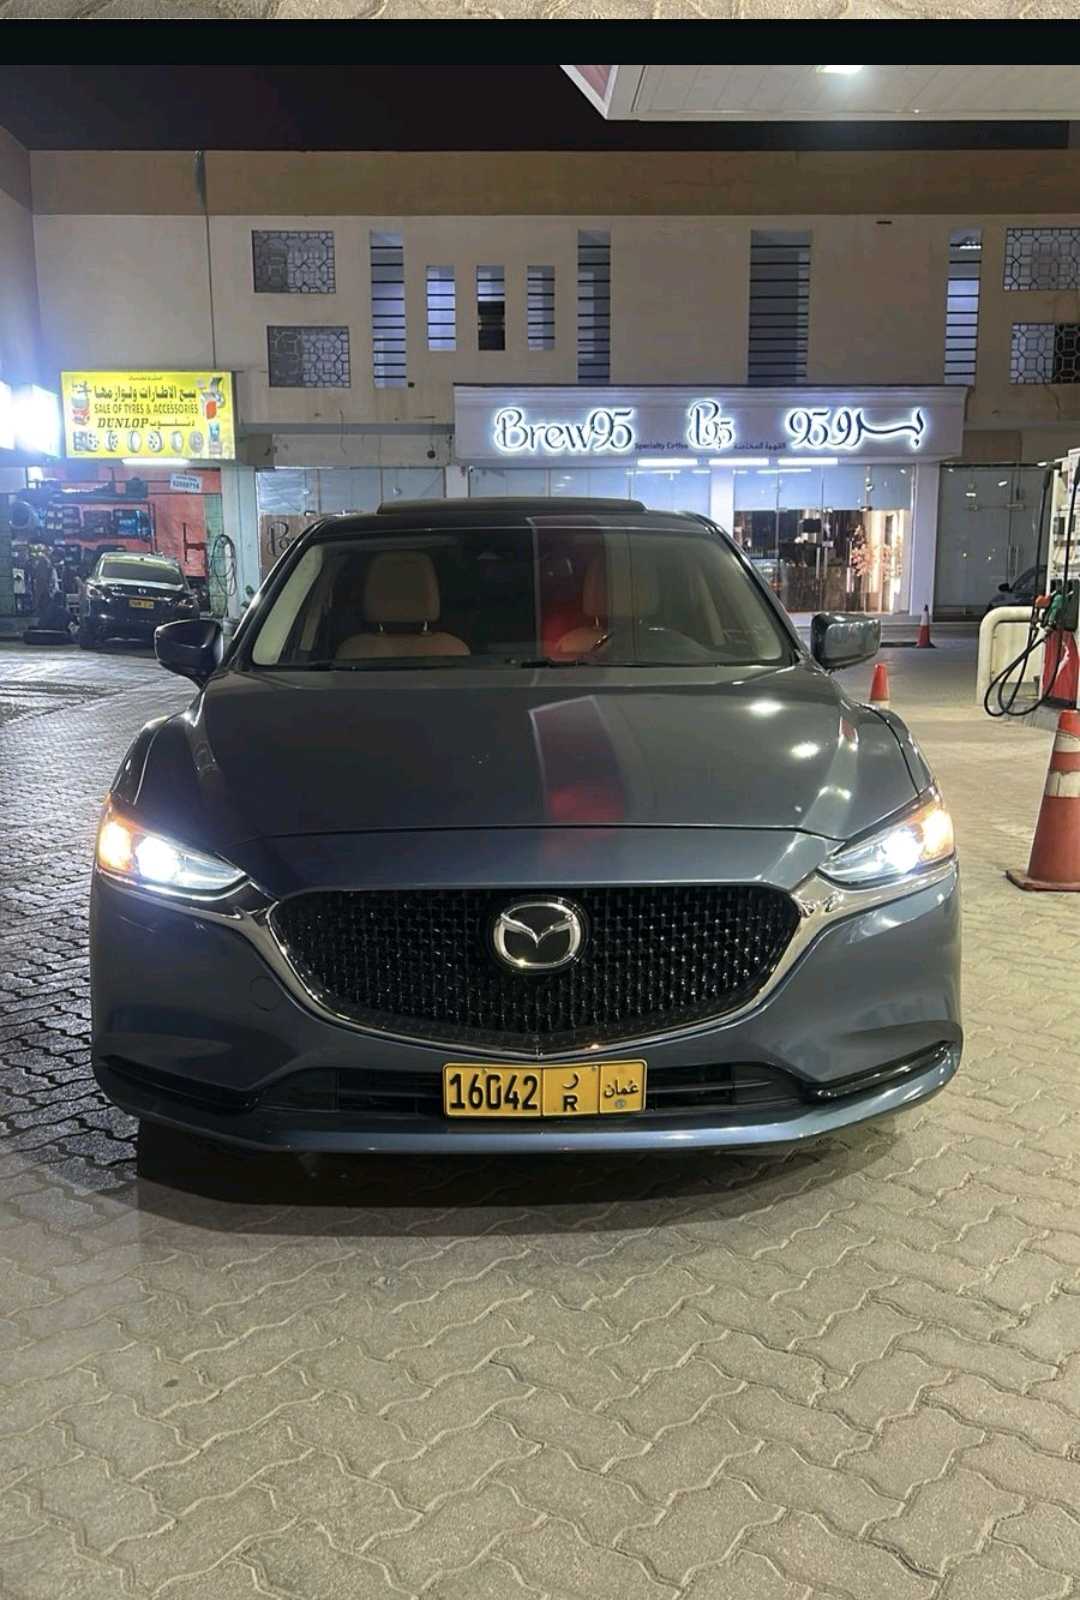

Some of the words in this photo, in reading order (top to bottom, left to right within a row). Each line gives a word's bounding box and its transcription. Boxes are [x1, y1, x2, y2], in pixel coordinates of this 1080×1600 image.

[179, 388, 197, 402] بيع
[94, 403, 111, 414] SALE
[113, 403, 122, 414] OF
[124, 403, 144, 414] TYRES
[146, 403, 151, 414] &
[153, 403, 199, 414] ACCESSORIES
[97, 417, 149, 428] DUNLOP
[495, 407, 635, 449] Brew95
[635, 442, 665, 450] Specialty
[666, 442, 689, 450] Coffee
[449, 1073, 538, 1110] 16042
[562, 1095, 579, 1112] R
